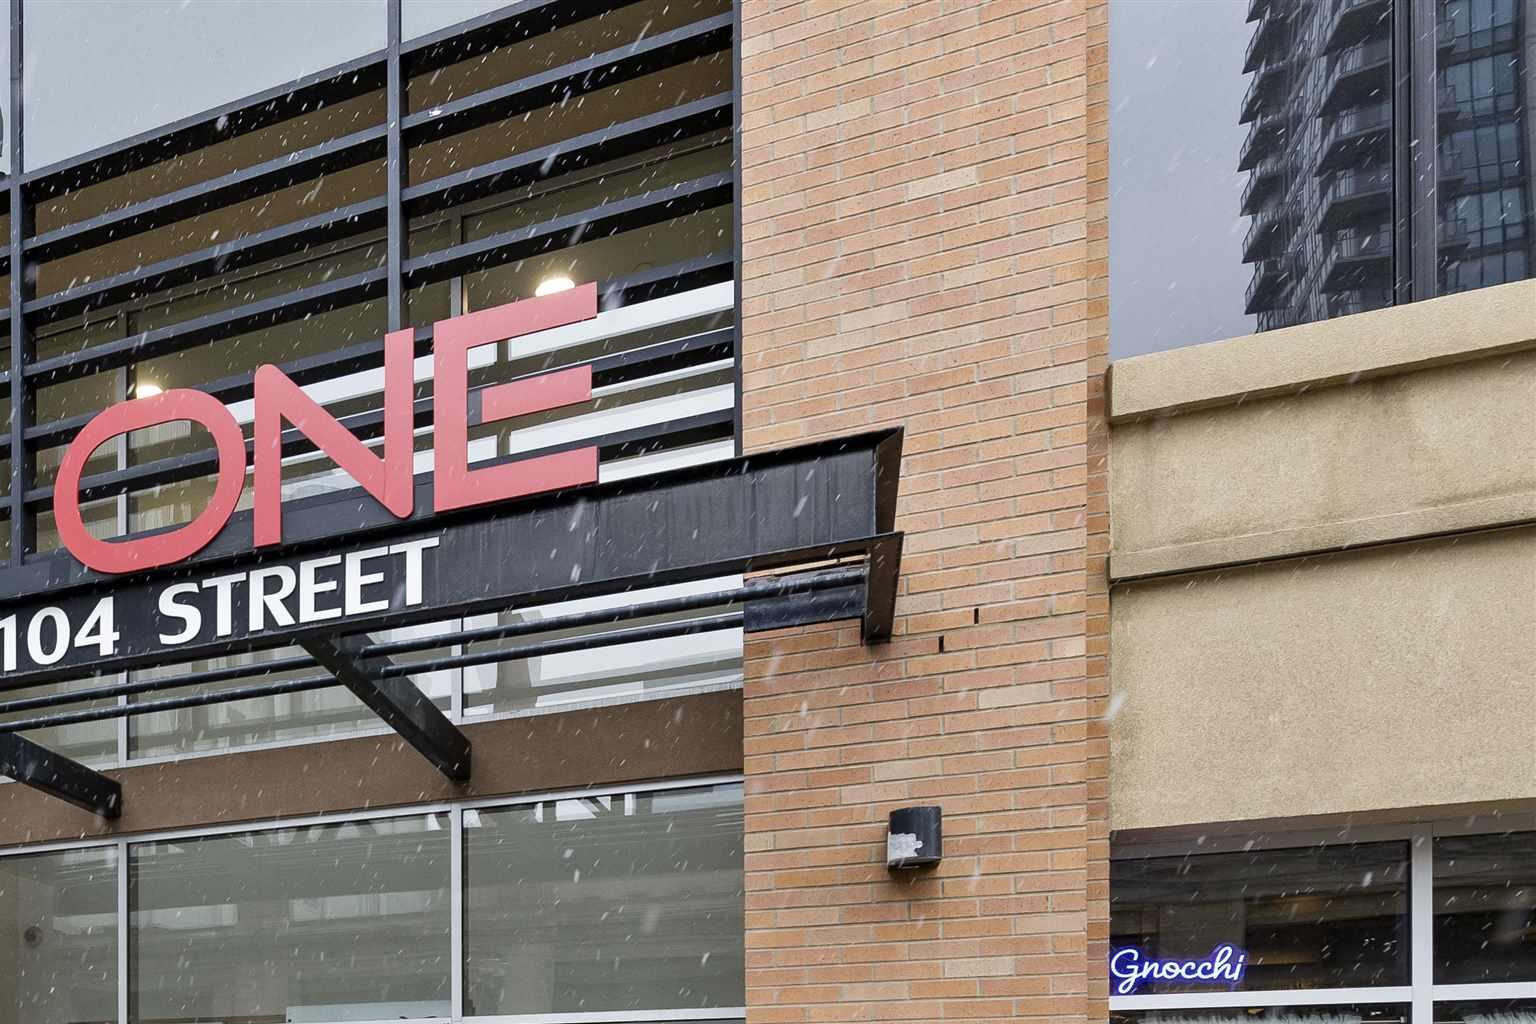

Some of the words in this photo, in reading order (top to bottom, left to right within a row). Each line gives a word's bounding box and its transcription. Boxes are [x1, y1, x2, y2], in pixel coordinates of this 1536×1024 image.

[53, 281, 598, 574] ONE
[158, 536, 440, 646] STREET
[1111, 946, 1245, 993] Gnocchi
